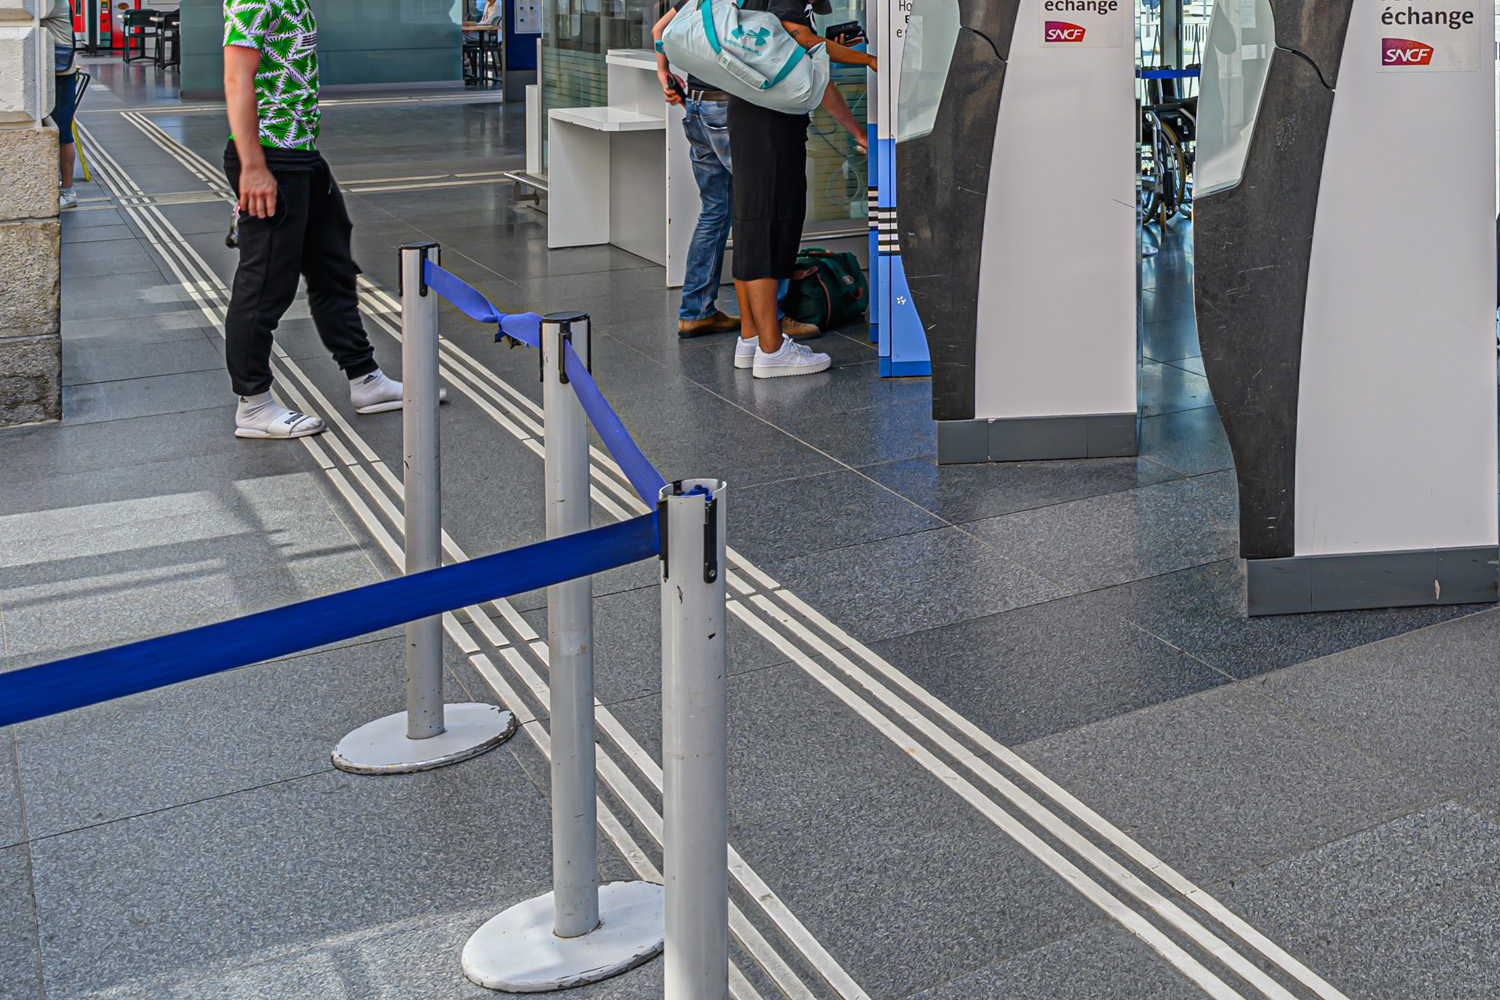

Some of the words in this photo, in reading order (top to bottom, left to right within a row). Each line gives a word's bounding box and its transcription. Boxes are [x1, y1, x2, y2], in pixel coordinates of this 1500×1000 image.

[1381, 6, 1474, 30] échange
[1046, 29, 1083, 40] SNCF
[1384, 48, 1430, 62] SNCF
